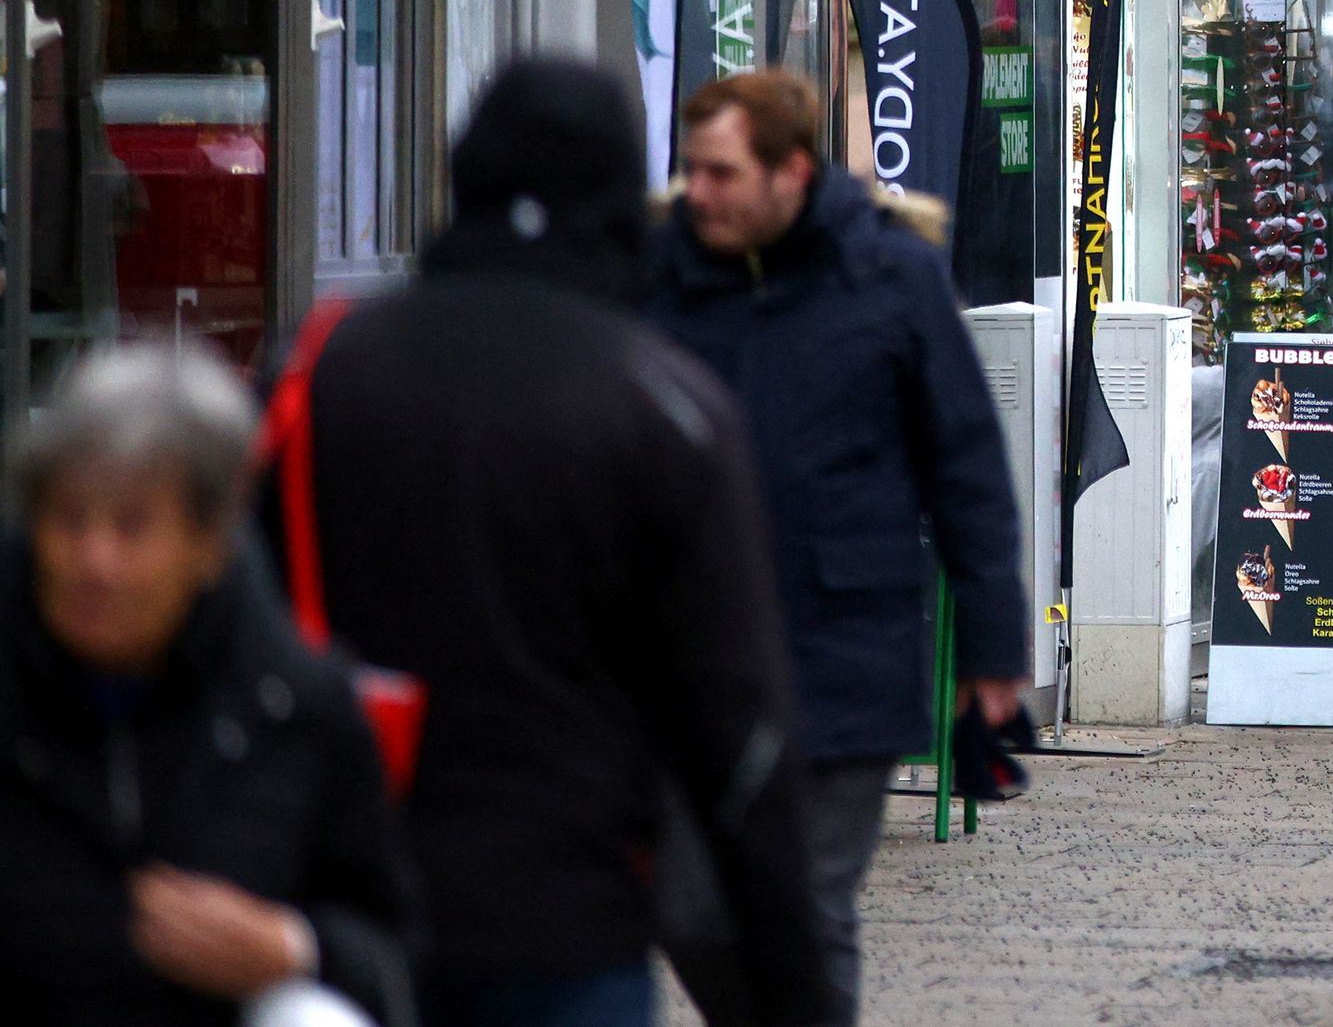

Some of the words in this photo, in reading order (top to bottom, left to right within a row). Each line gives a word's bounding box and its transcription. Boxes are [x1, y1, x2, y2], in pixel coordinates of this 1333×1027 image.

[1001, 120, 1028, 166] STORE
[1293, 406, 1329, 414] Schlagsahne
[1247, 420, 1333, 432] Schokoladentraum
[1299, 488, 1333, 496] Schlagsahne
[1243, 509, 1311, 520] Erdbeerwunder
